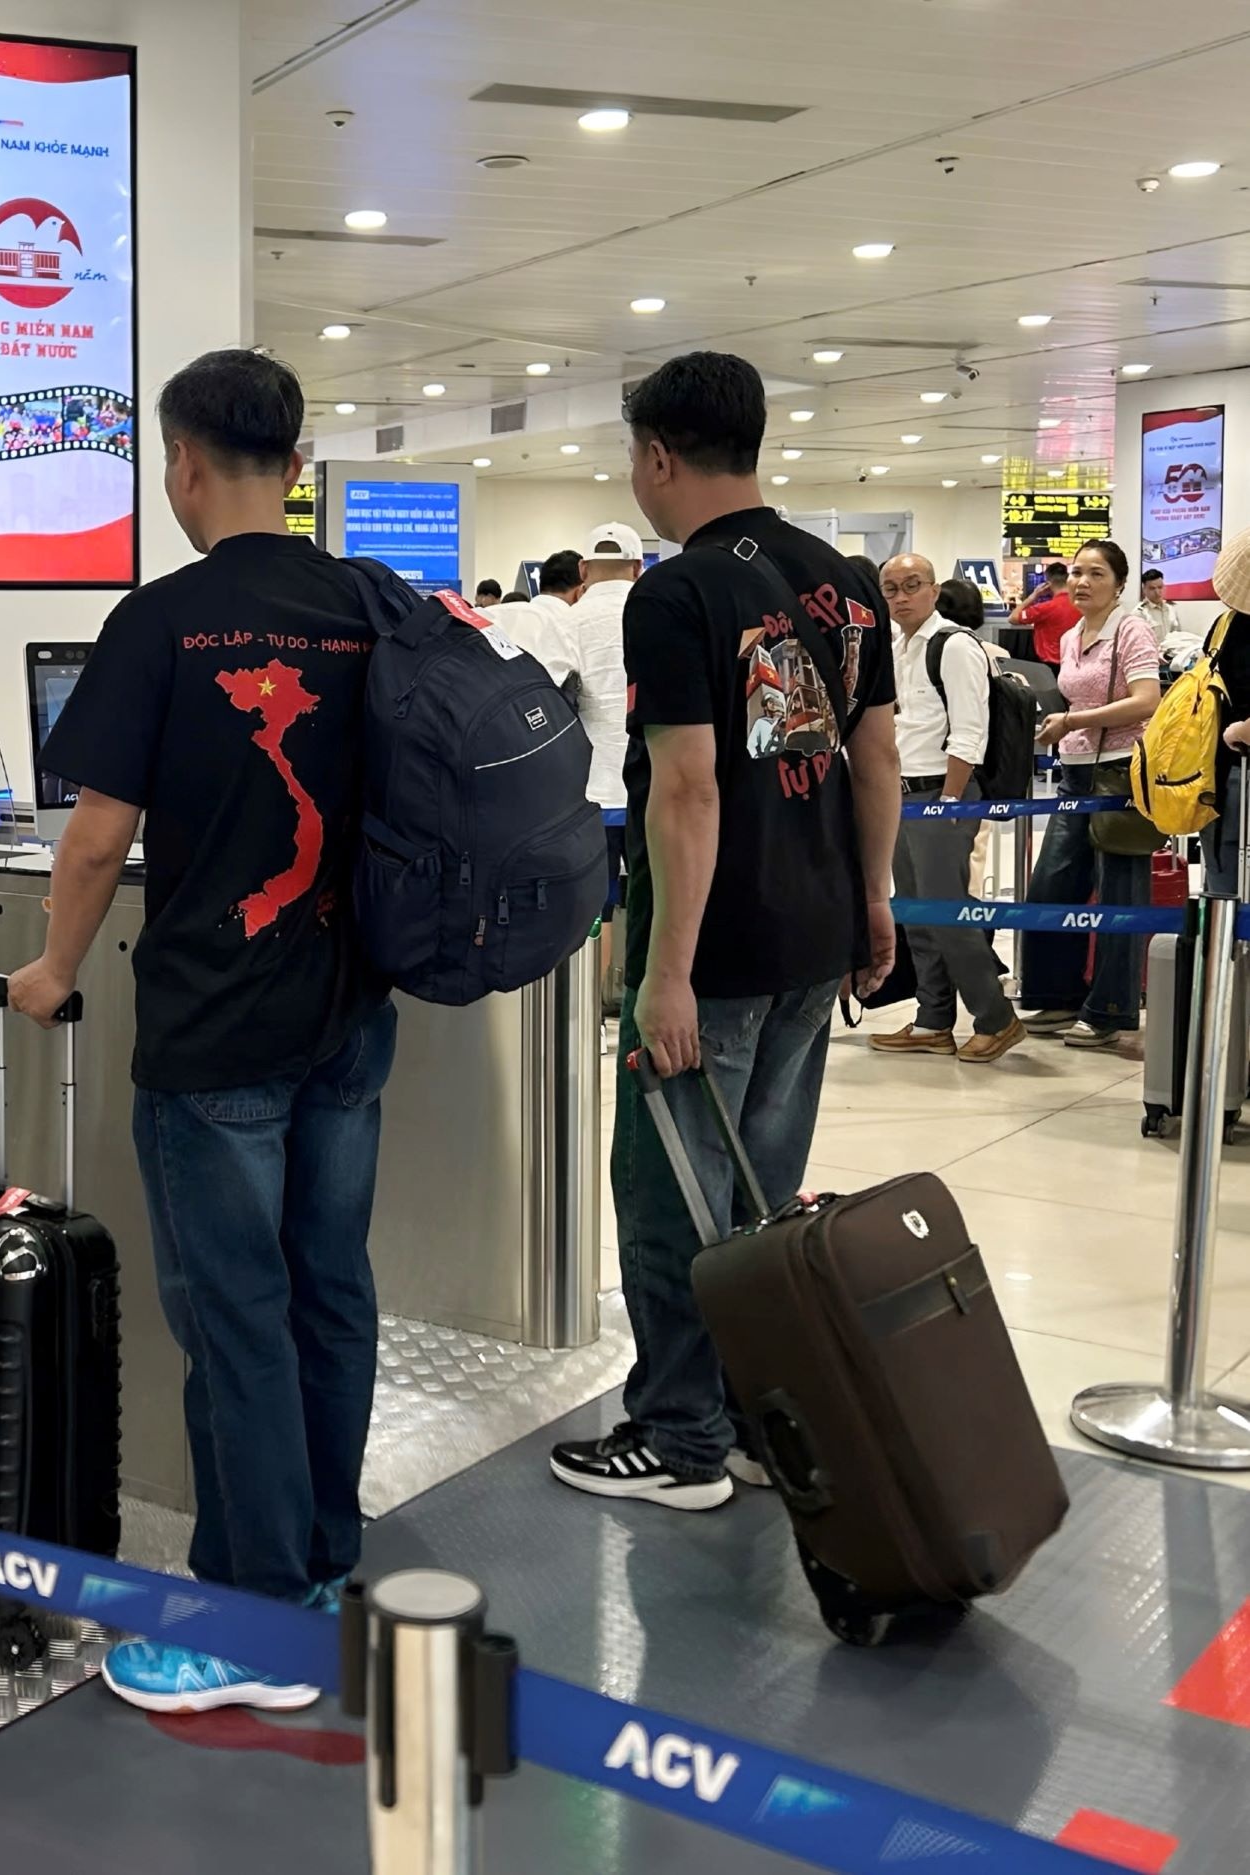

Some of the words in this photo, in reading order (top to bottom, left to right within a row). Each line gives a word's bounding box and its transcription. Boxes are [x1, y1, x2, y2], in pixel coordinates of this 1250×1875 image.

[1, 138, 30, 151] NAM
[15, 319, 55, 337] MIỀN
[61, 324, 94, 339] NAM
[0, 339, 31, 357] ĐẤT
[183, 633, 219, 650] ĐỘC
[224, 630, 253, 648] LẬP
[267, 633, 285, 649] TỰ
[288, 636, 308, 649] DO
[321, 639, 360, 655] HẠNH
[923, 805, 944, 815] ACV
[989, 804, 1009, 814] ACV
[1058, 800, 1078, 811] ACV
[957, 907, 996, 922] ACV
[1062, 913, 1103, 928] ACV
[604, 1720, 740, 1802] ACV
